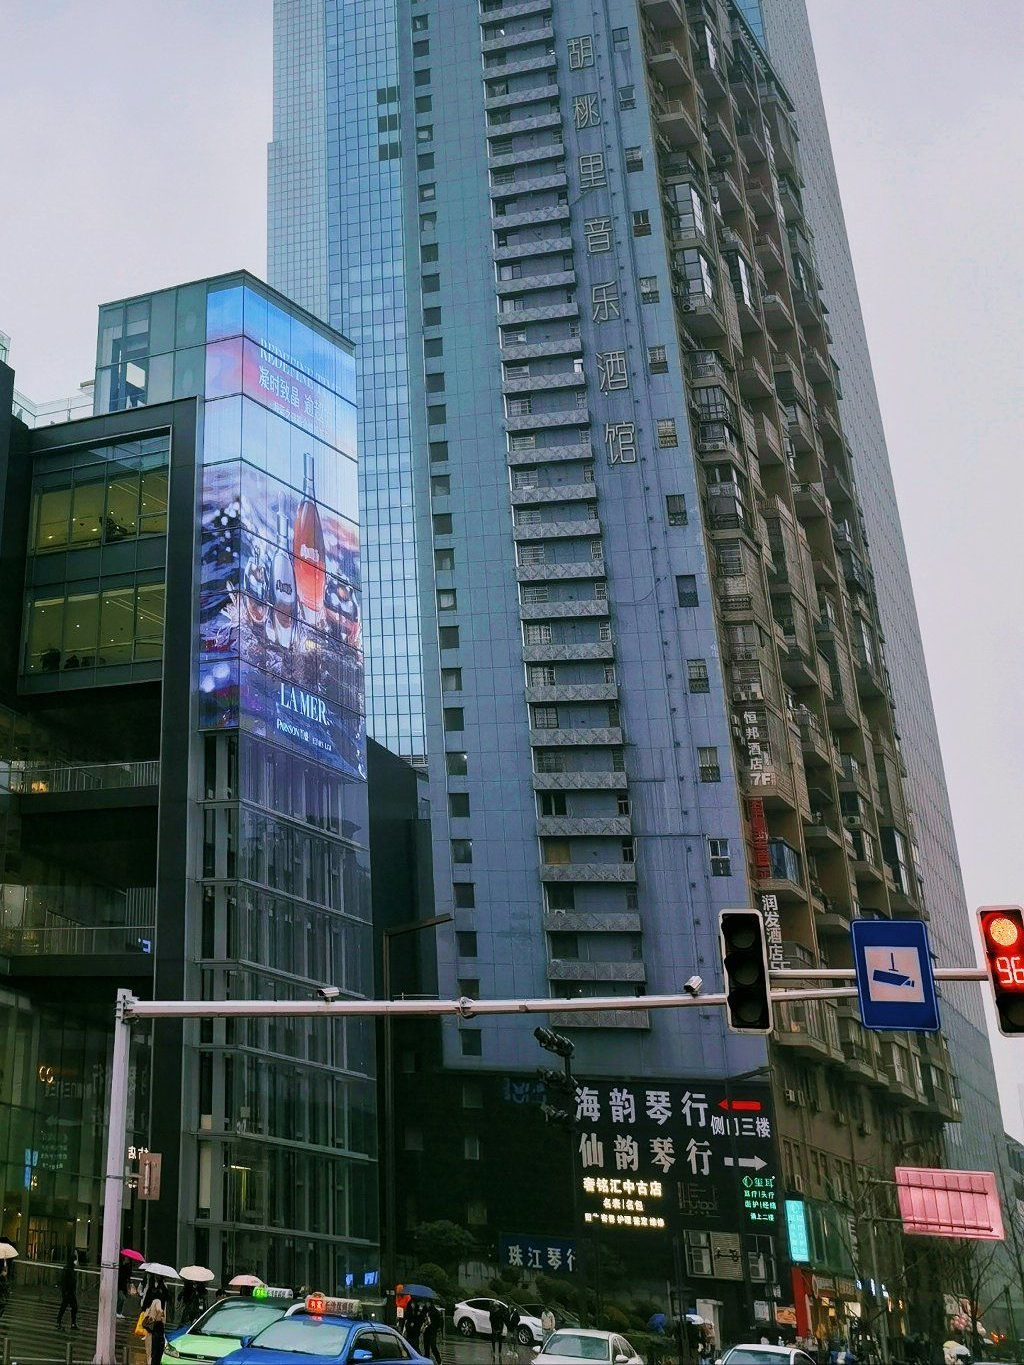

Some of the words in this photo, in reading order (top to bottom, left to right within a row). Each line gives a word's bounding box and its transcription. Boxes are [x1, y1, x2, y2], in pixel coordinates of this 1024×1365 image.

[567, 35, 636, 464] 胡桃里音乐酒馆
[281, 682, 298, 712] LA
[300, 691, 329, 726] MER
[996, 956, 1024, 984] 96
[574, 1086, 708, 1127] 海韵琴行
[710, 1115, 771, 1138] 侧门三楼
[579, 1133, 713, 1175] 仙韵琴行
